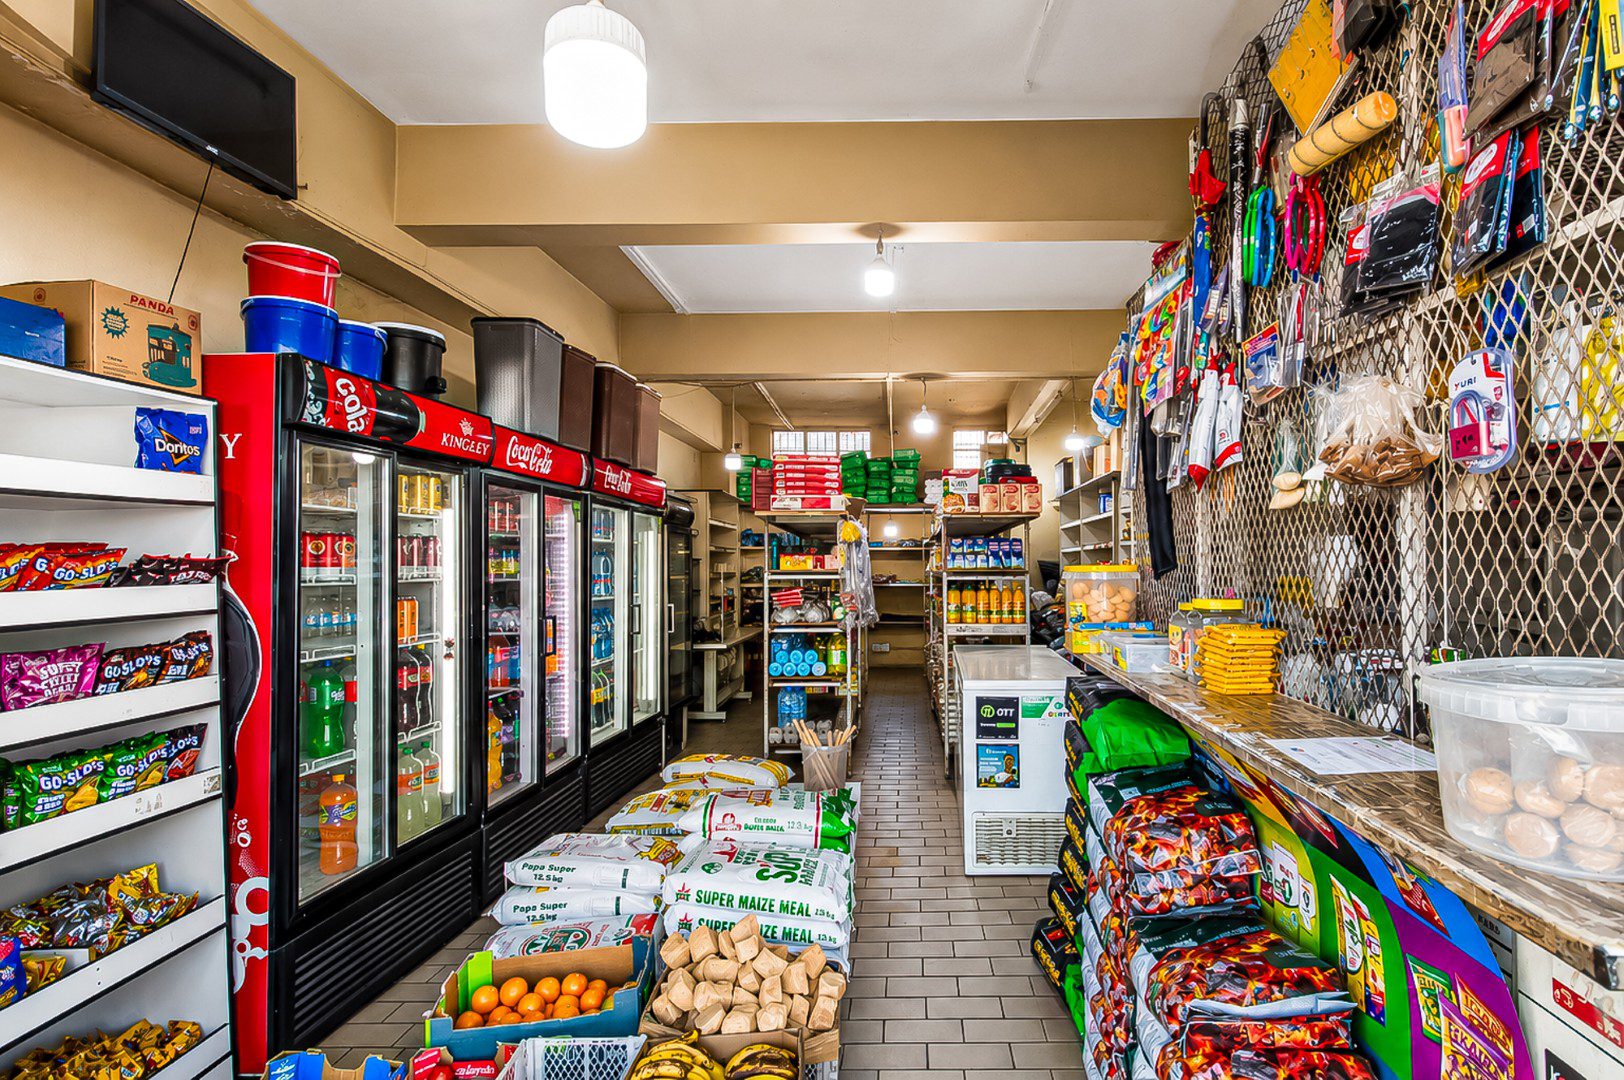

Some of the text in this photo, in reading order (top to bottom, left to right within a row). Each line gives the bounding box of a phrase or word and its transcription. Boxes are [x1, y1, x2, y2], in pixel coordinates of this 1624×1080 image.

[130, 294, 174, 316] PANDA
[1454, 376, 1477, 391] YURI
[154, 438, 200, 456] Doritos
[441, 432, 491, 456] KINGLEY
[521, 862, 576, 873] Papa Super
[513, 902, 568, 913] Papa Super
[695, 889, 734, 908] SUPER
[738, 895, 775, 913] MAIZE
[779, 900, 811, 917] MEAL
[781, 926, 814, 944] MEAL
